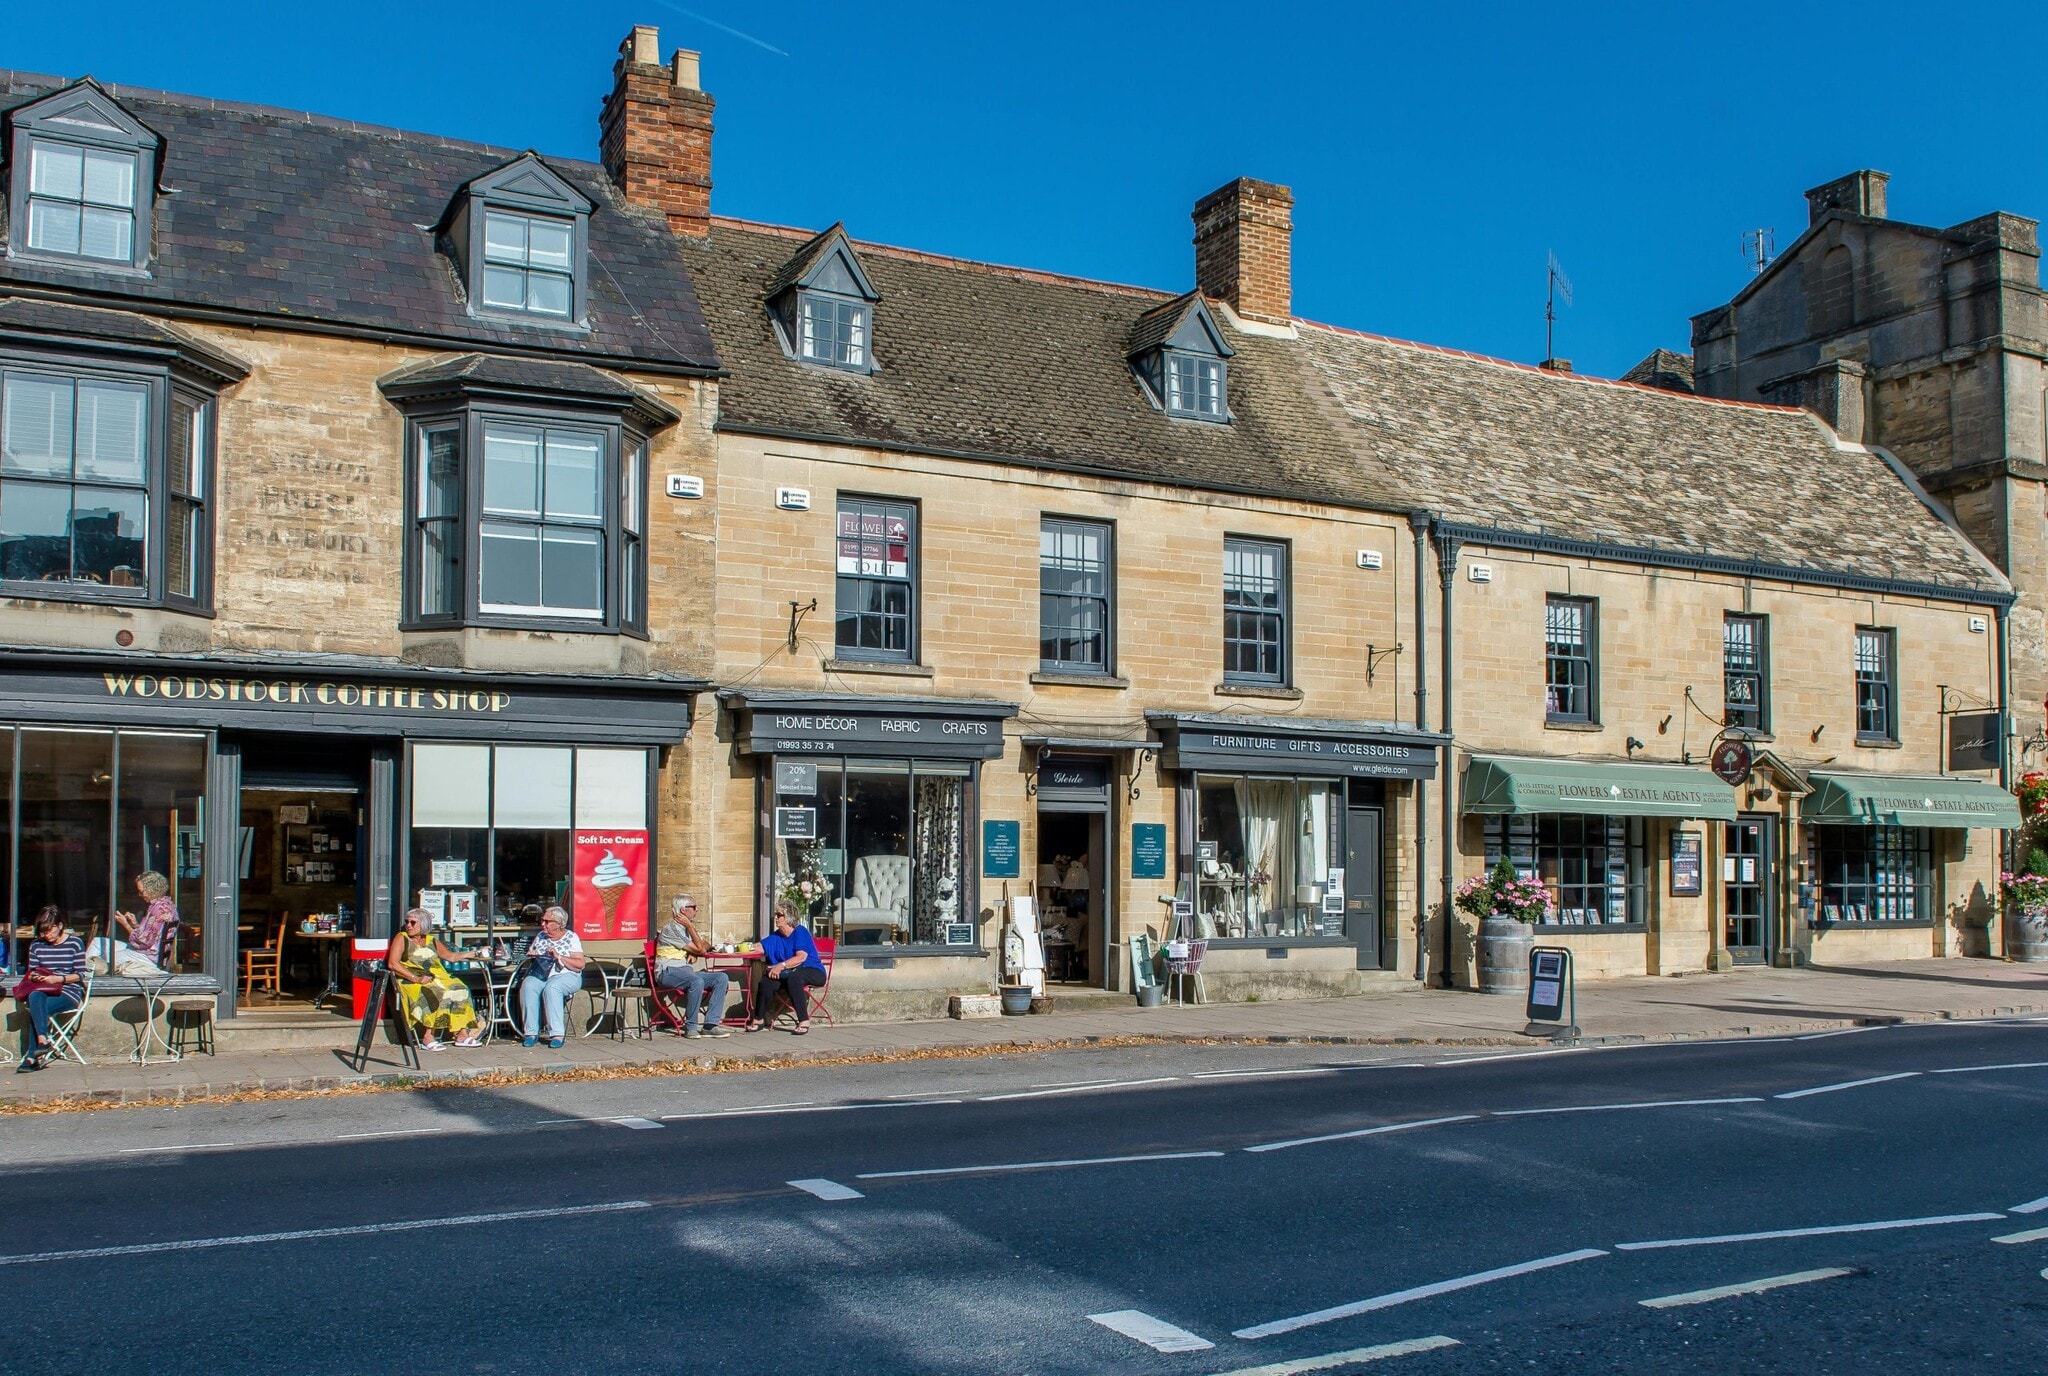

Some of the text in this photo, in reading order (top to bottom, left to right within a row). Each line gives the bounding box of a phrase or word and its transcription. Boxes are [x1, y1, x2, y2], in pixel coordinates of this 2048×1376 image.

[103, 672, 511, 712] WOODSTOCK COFFEE SHOP
[776, 715, 988, 735] HOME DÉCOR FABRIC CRAFTS
[777, 741, 835, 751] 01993 35 73 74
[1212, 735, 1410, 758] FURNITURE GIFTS ACCESSORIES
[1718, 742, 1745, 754] FLOWERS
[789, 766, 807, 775] 20%
[1558, 785, 1702, 802] FLOWERS ESTATE AGENTS
[1884, 798, 1925, 809] FLOWERS
[1933, 800, 1963, 811] ESTATE
[1965, 801, 1996, 812] AGENTS
[578, 835, 645, 844] Soft Ice Cream
